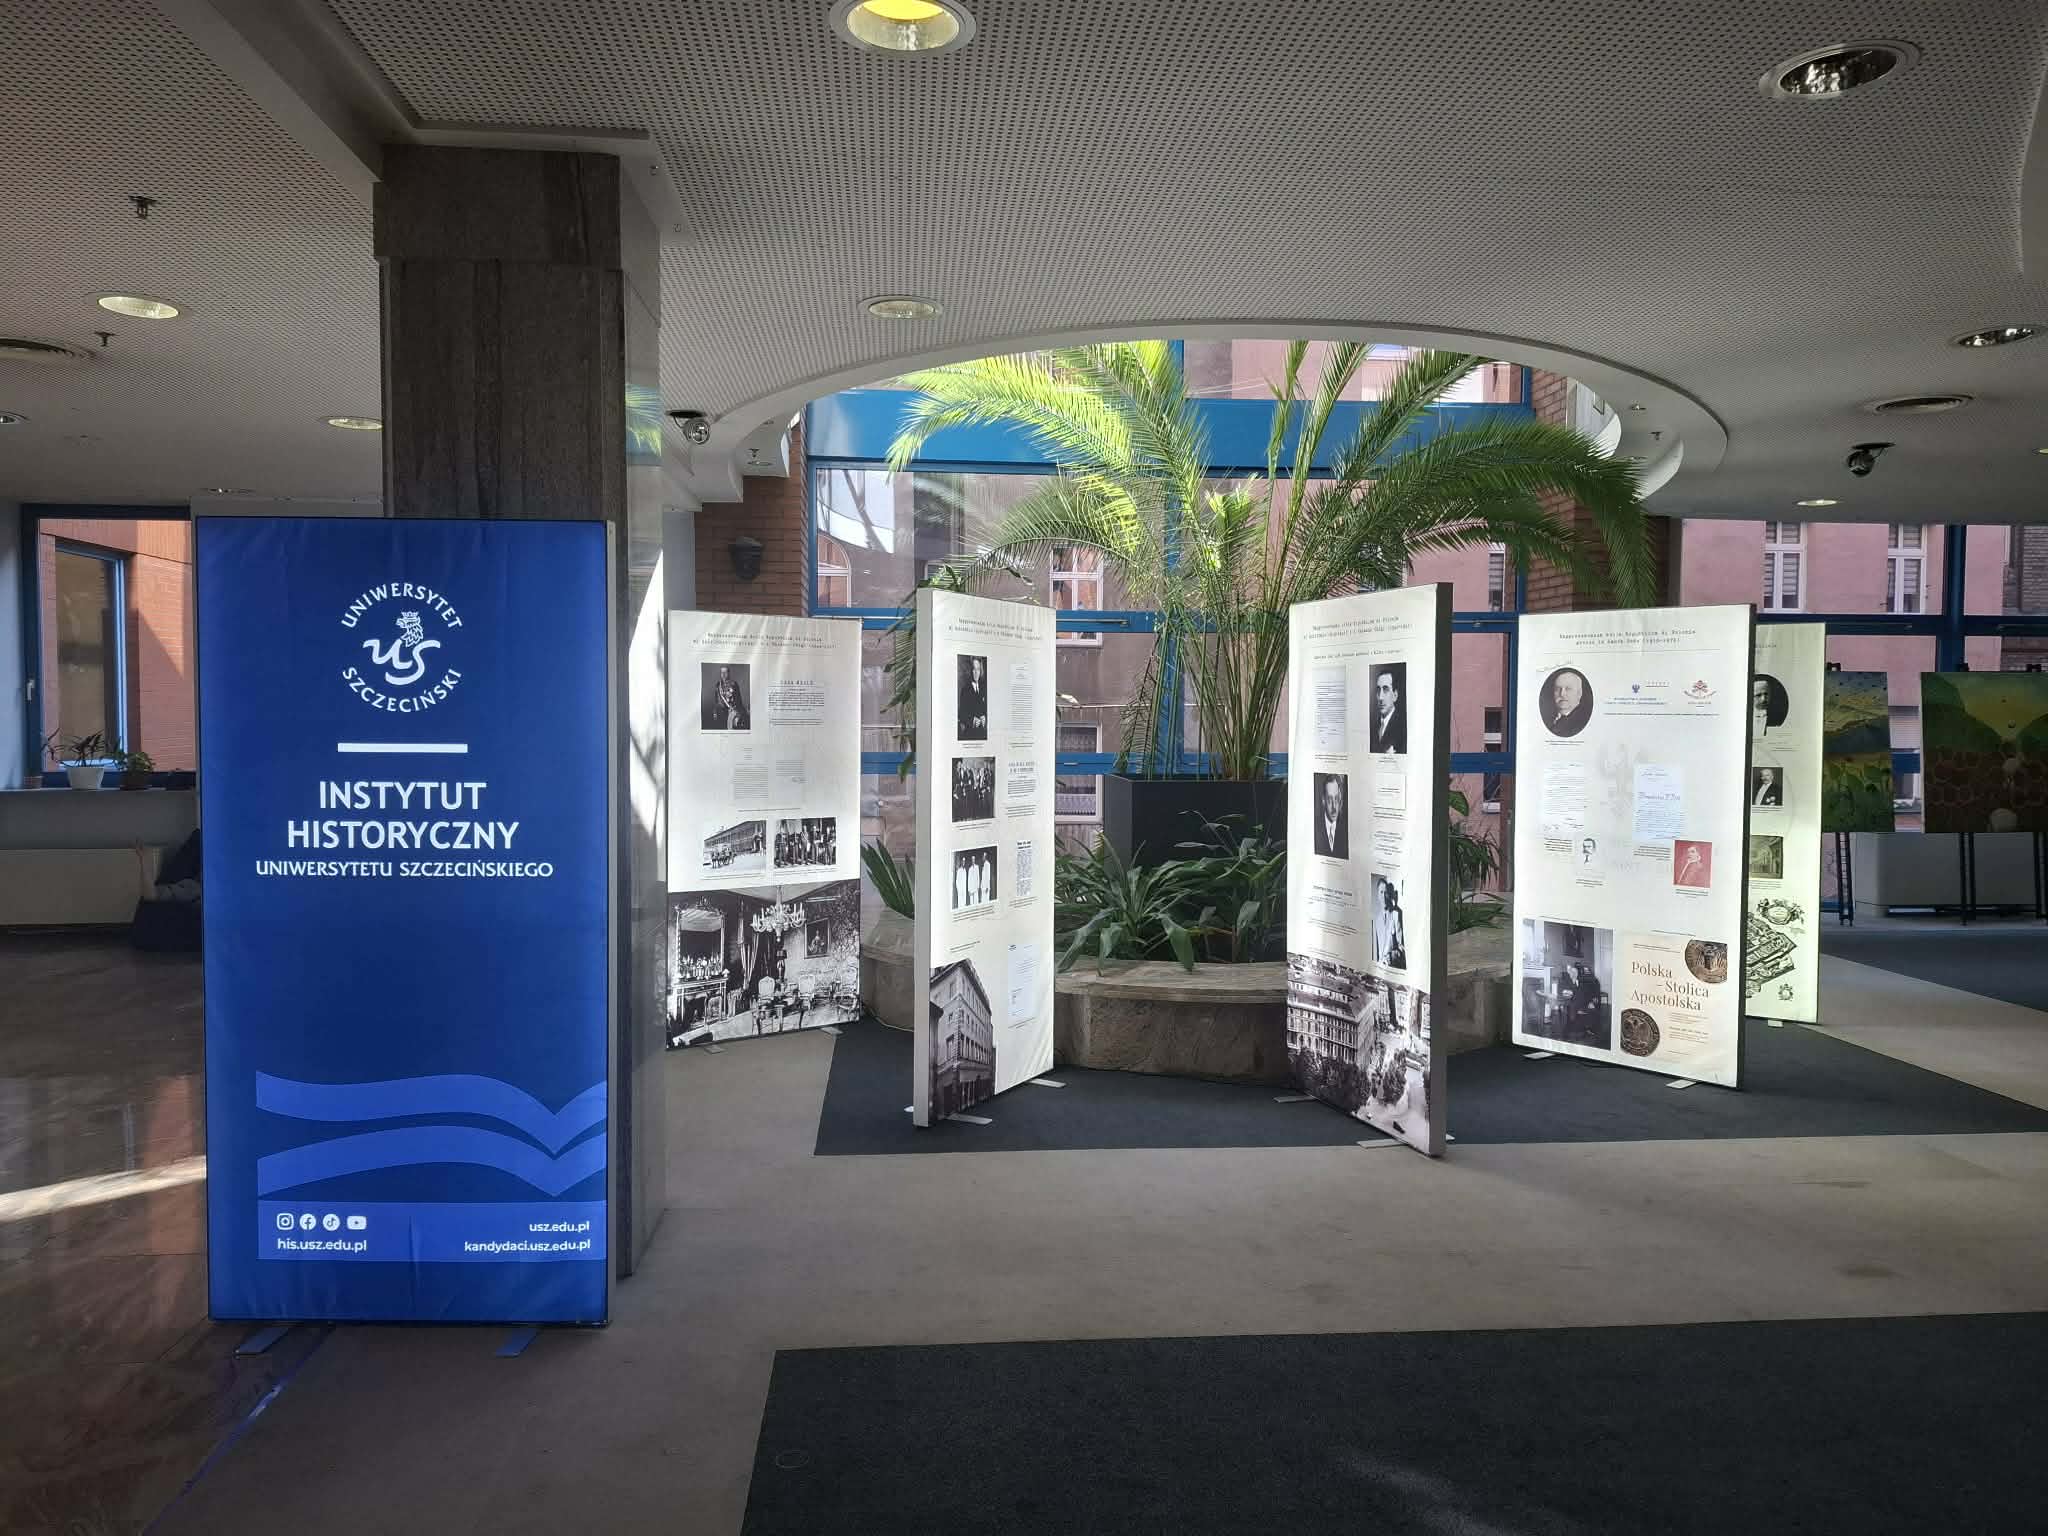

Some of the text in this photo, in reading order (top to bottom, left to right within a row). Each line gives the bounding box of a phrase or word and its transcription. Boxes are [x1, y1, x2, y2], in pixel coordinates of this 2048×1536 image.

[341, 582, 463, 629] UNIWERSYTET
[342, 666, 462, 713] SZCZECIŃSKI
[319, 781, 487, 810] INSTYTUT
[287, 820, 520, 850] HISTORYCZNY
[255, 859, 554, 878] UNIWERSYTETU SZCZECIŃSKIEGO
[1632, 961, 1672, 978] Polska
[1664, 981, 1709, 998] Stolica
[1631, 989, 1701, 1011] Apostolska
[529, 1220, 590, 1233] usz.edu.pl
[277, 1237, 367, 1253] his.usz.edu.pl
[464, 1238, 591, 1254] kandydaci.usz.edu.pl
